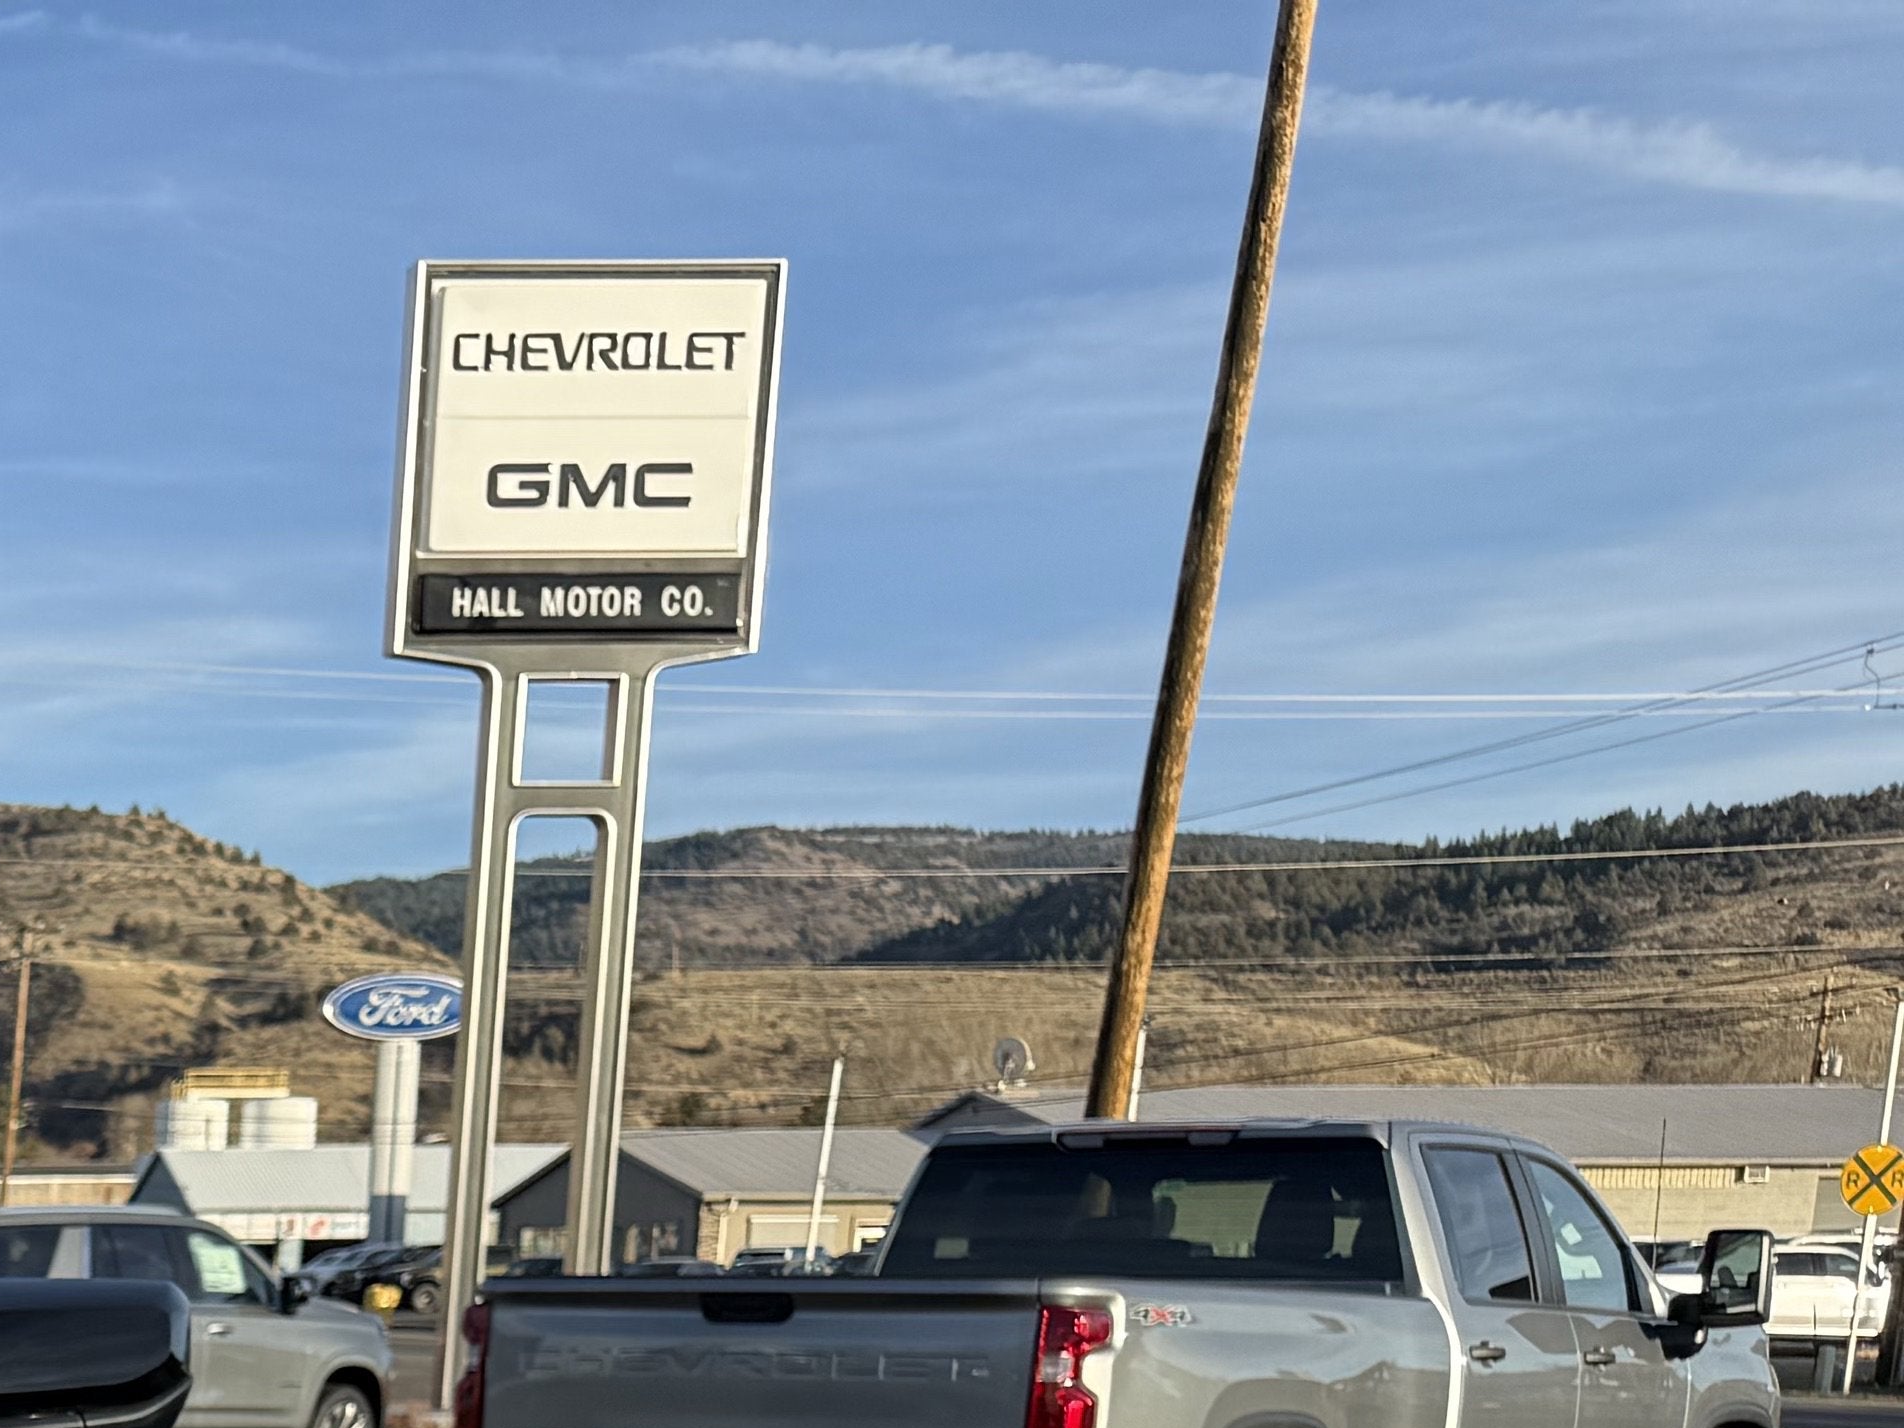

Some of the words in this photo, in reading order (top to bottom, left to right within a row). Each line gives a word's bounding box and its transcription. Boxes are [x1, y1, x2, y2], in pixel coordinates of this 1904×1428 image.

[453, 331, 746, 371] CHEVROLET
[486, 462, 694, 508] GMC
[451, 586, 525, 618] HALL
[539, 586, 642, 617] MOTOR
[660, 586, 714, 617] CO.
[358, 985, 453, 1027] Ford
